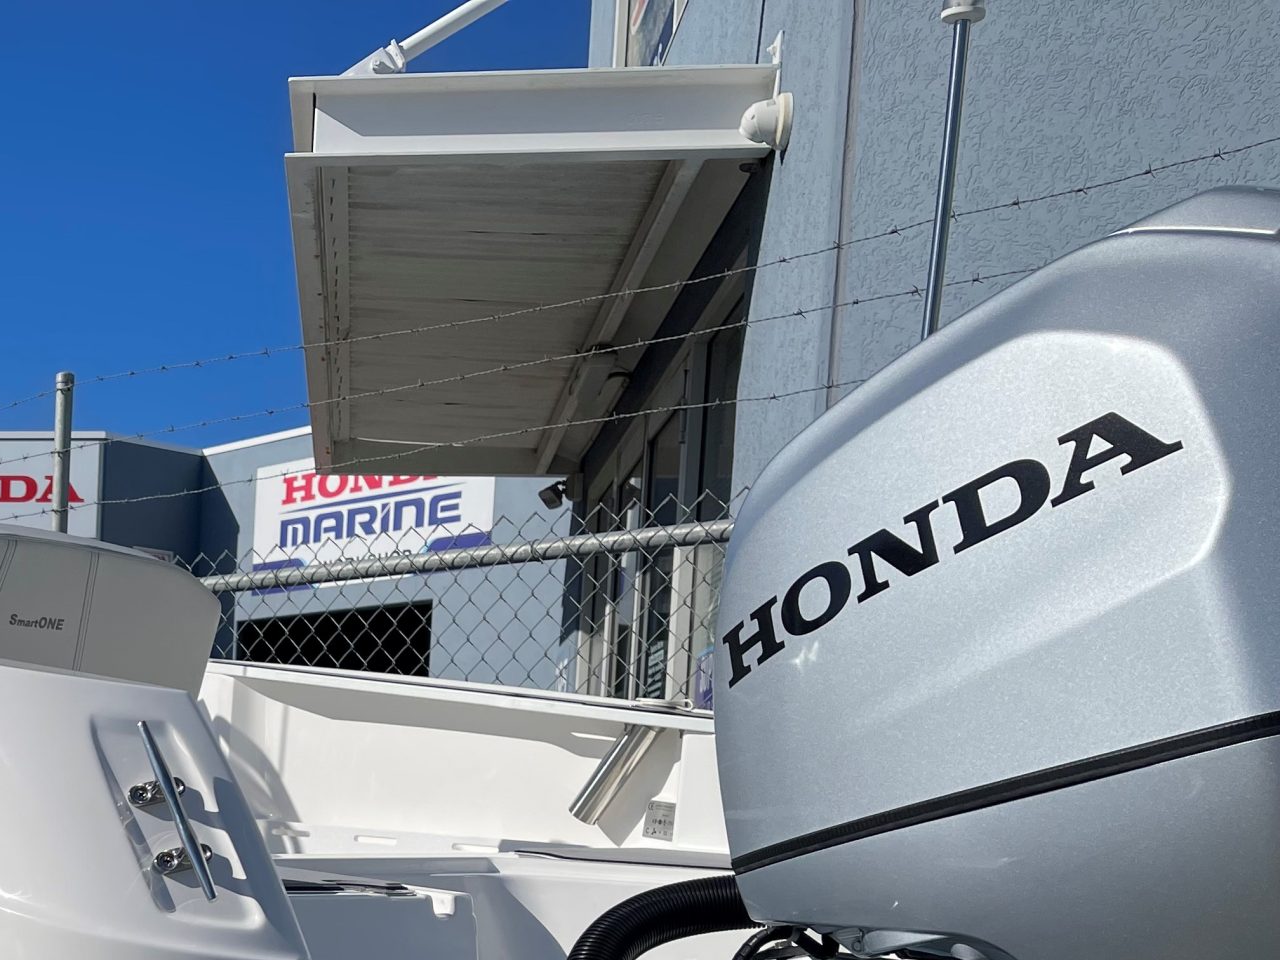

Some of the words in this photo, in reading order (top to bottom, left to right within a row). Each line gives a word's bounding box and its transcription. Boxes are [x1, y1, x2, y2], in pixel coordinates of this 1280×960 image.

[281, 473, 445, 505] HON
[280, 491, 462, 548] MARINE
[721, 411, 1184, 688] HONDA
[9, 613, 65, 631] SmartONE
